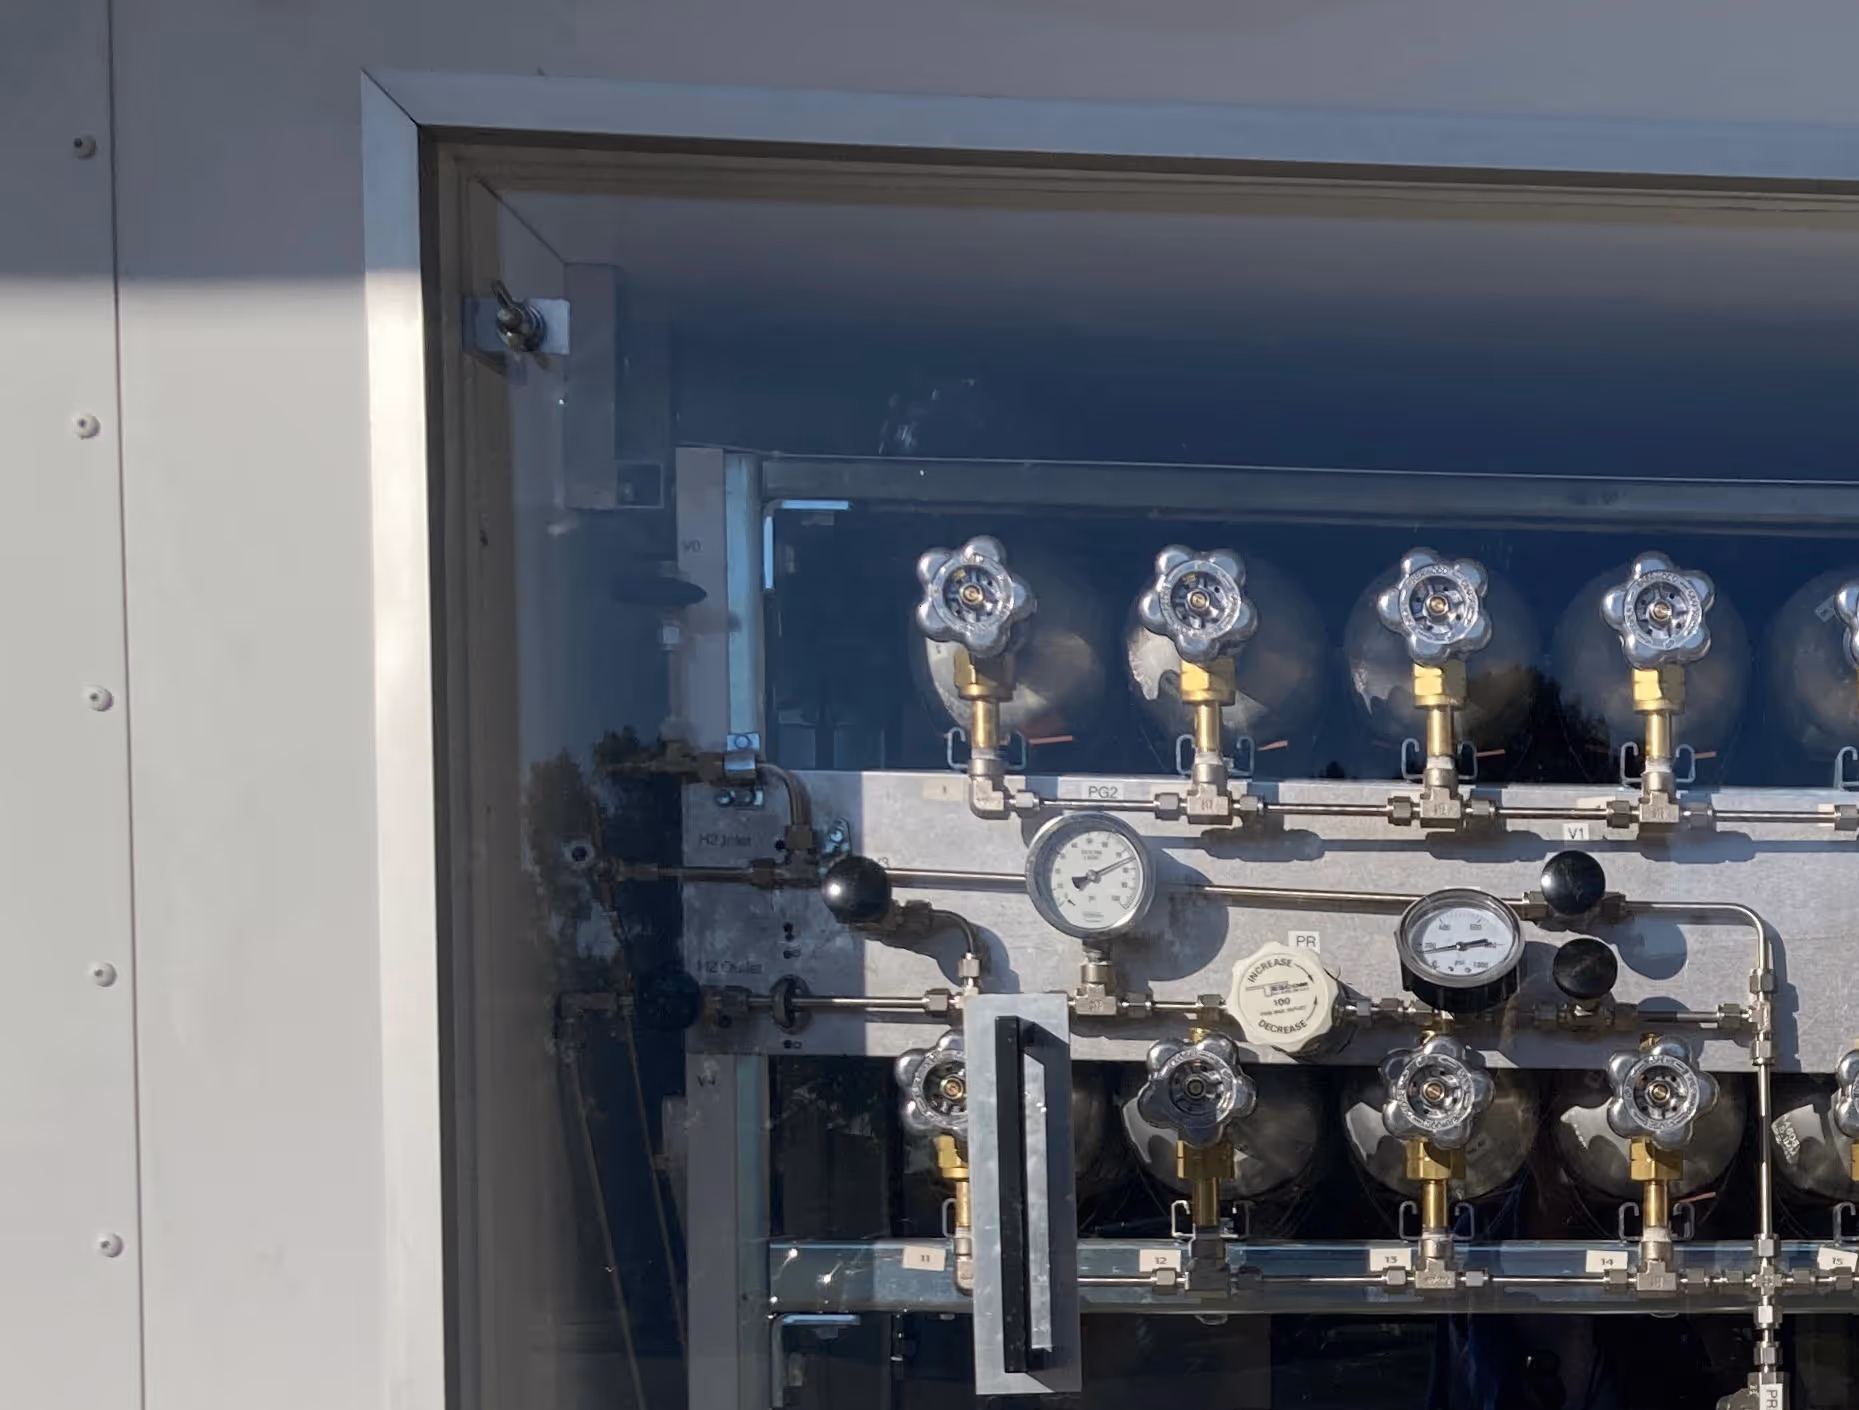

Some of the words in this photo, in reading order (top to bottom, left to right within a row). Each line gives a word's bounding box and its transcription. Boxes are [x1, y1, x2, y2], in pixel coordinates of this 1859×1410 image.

[1088, 785, 1118, 799] PG2
[1567, 827, 1584, 840] V1
[1296, 935, 1317, 948] PR
[1247, 958, 1293, 984] INCREASE
[1258, 1019, 1308, 1034] DECREASE
[920, 1254, 930, 1263] 11
[1154, 1256, 1167, 1264] 12
[1601, 1257, 1614, 1266] 14
[1831, 1256, 1844, 1265] 15
